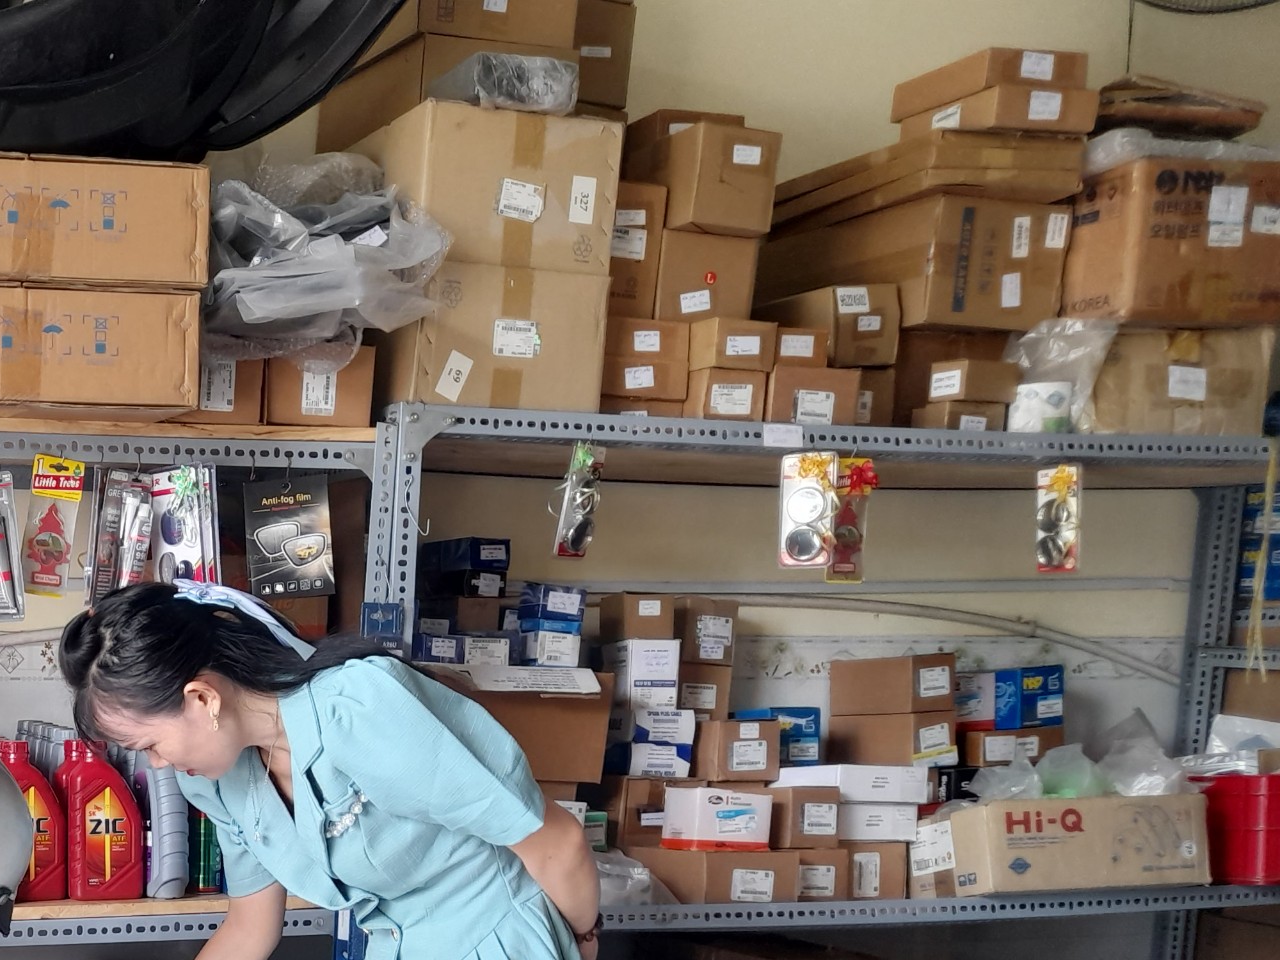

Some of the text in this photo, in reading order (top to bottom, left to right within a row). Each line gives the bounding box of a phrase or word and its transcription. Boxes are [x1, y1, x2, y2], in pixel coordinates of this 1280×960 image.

[580, 191, 589, 212] 327
[1072, 296, 1110, 312] KOREA
[35, 477, 80, 488] Little Trees
[262, 493, 311, 505] Anti-fog film
[89, 818, 126, 834] ZIC
[1005, 808, 1085, 834] Hi-Q
